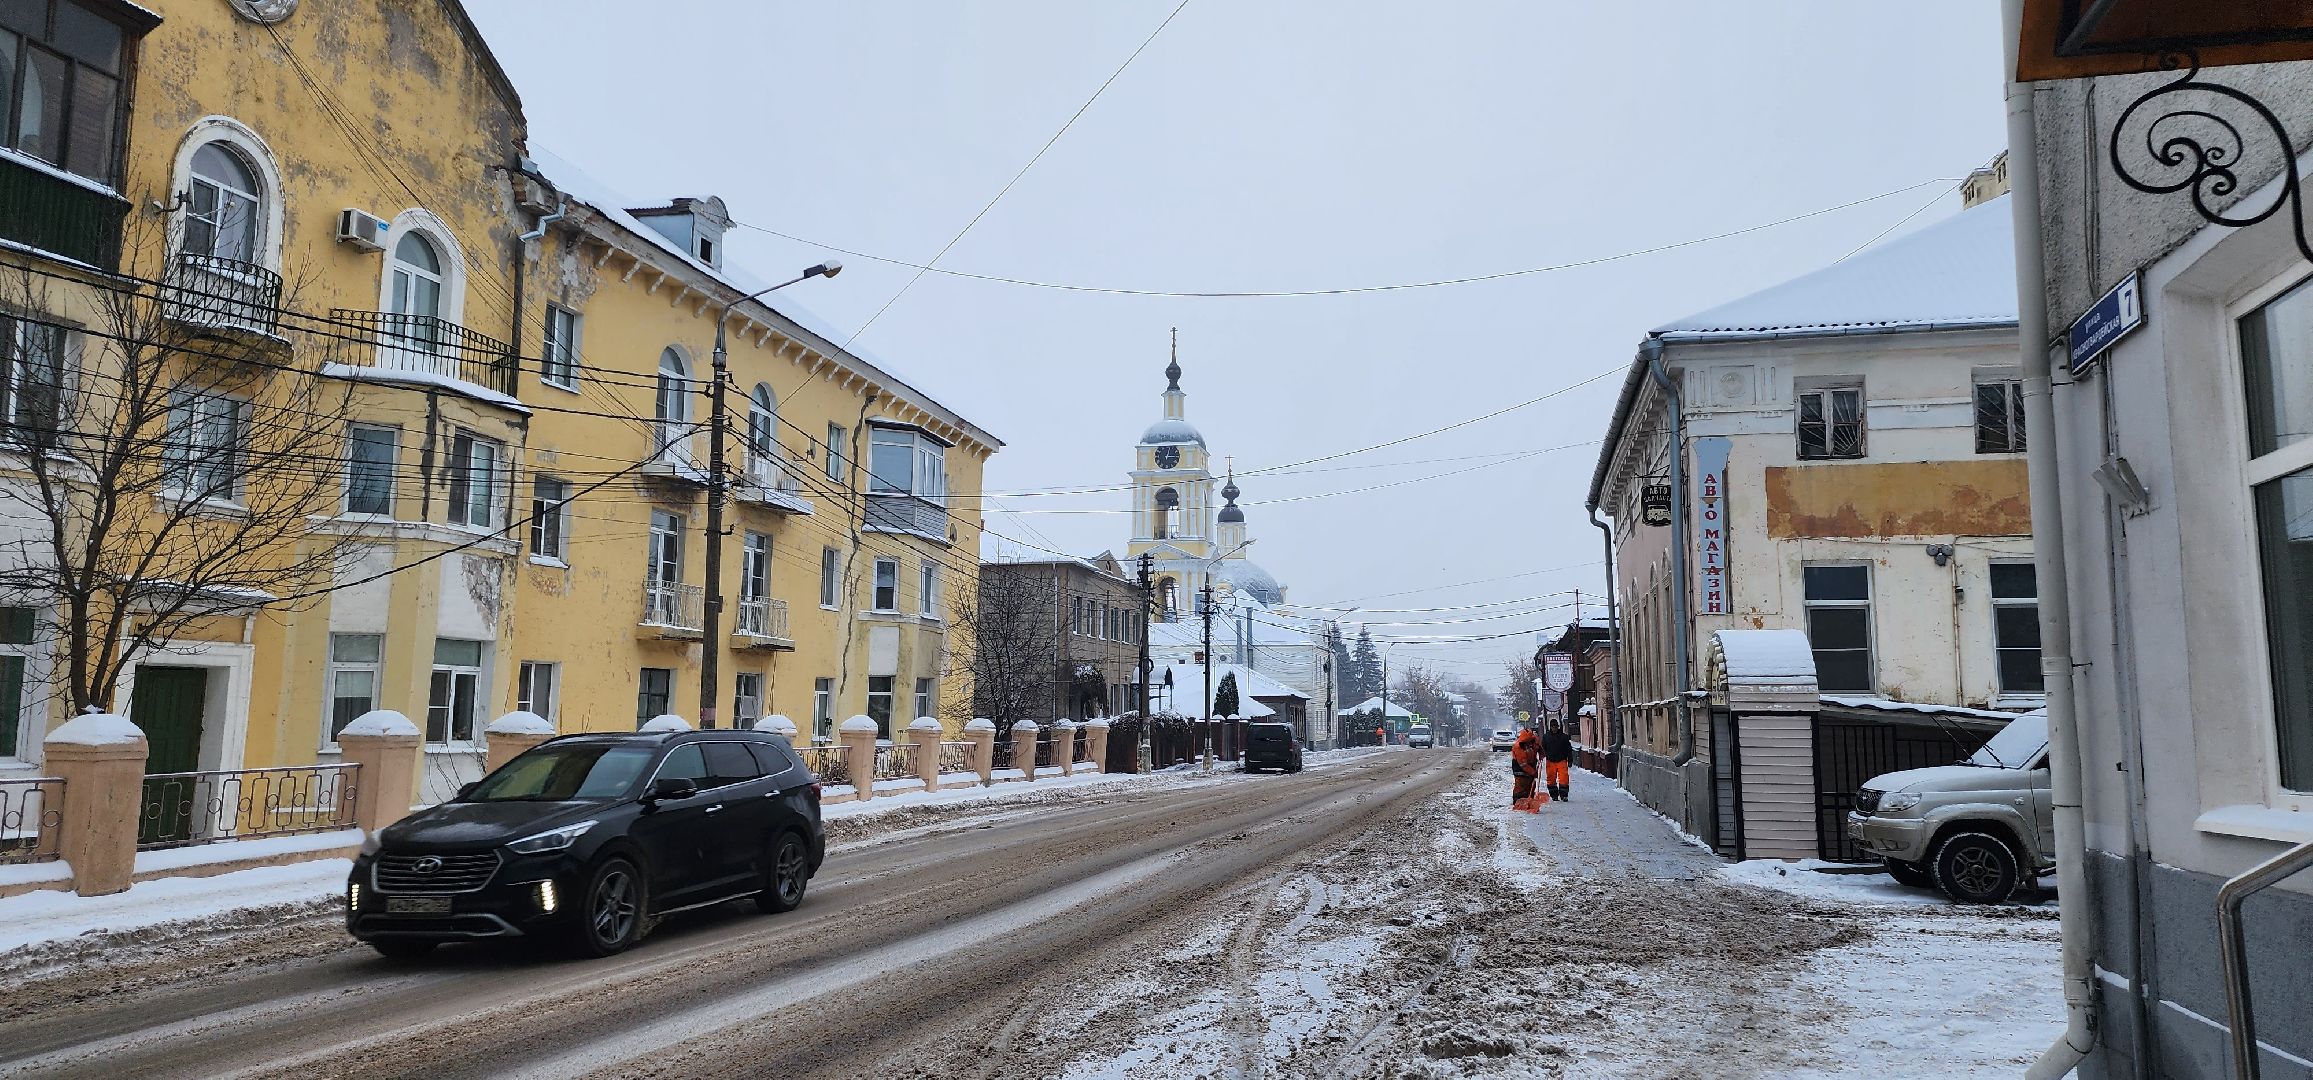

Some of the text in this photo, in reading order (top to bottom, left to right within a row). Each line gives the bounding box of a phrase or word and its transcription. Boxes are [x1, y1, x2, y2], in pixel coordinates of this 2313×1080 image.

[2124, 288, 2132, 317] 7
[1704, 473, 1721, 613] АВО МАГАЗИН
